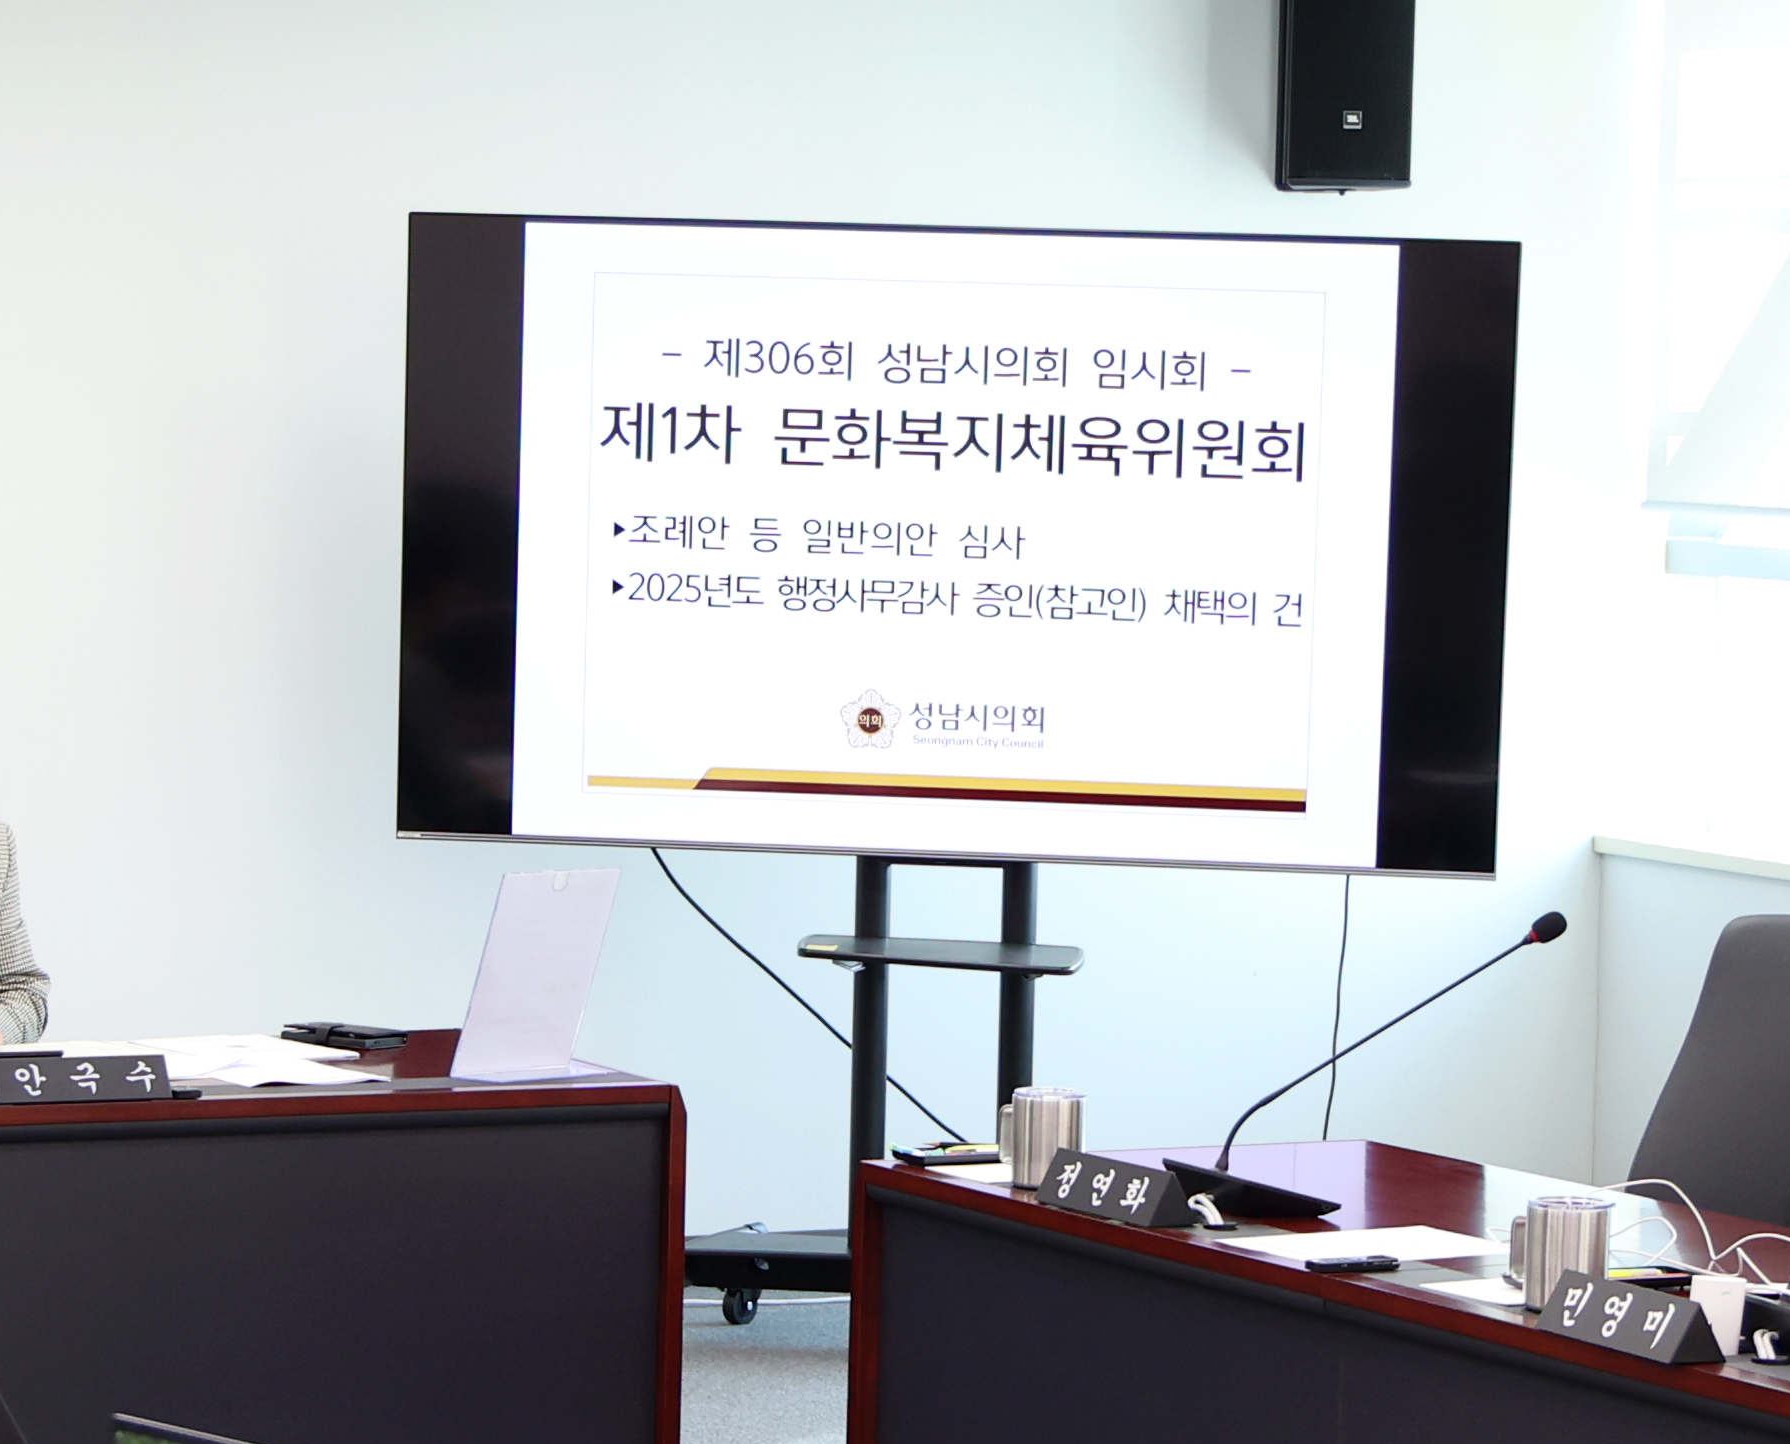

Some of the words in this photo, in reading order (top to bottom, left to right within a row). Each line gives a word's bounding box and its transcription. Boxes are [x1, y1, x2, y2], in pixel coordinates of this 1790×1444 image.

[704, 338, 852, 381] 제306회
[878, 343, 1067, 387] 성남시의회
[1094, 349, 1205, 391] 임시회
[601, 403, 742, 464] 제1차
[775, 408, 1304, 482] 문화복지체육위원회
[629, 516, 729, 550] 조례안
[750, 518, 781, 552] 등
[803, 520, 938, 556] 일반의안
[960, 525, 1025, 560] 심사
[629, 572, 764, 607] 2025년도
[778, 576, 959, 615] 행정사무감사
[973, 584, 1146, 622] 증인(참고인)
[1164, 589, 1256, 626] 채택의
[1274, 594, 1301, 627] 건
[858, 713, 883, 728] 의회
[910, 703, 1044, 733] 성남시의회
[913, 735, 973, 746] Seongnam
[976, 737, 998, 748] City
[1002, 738, 1043, 748] Council
[15, 1061, 155, 1095] 안극수
[1057, 1158, 1151, 1213] 정연화
[1563, 1283, 1675, 1348] 민영미
